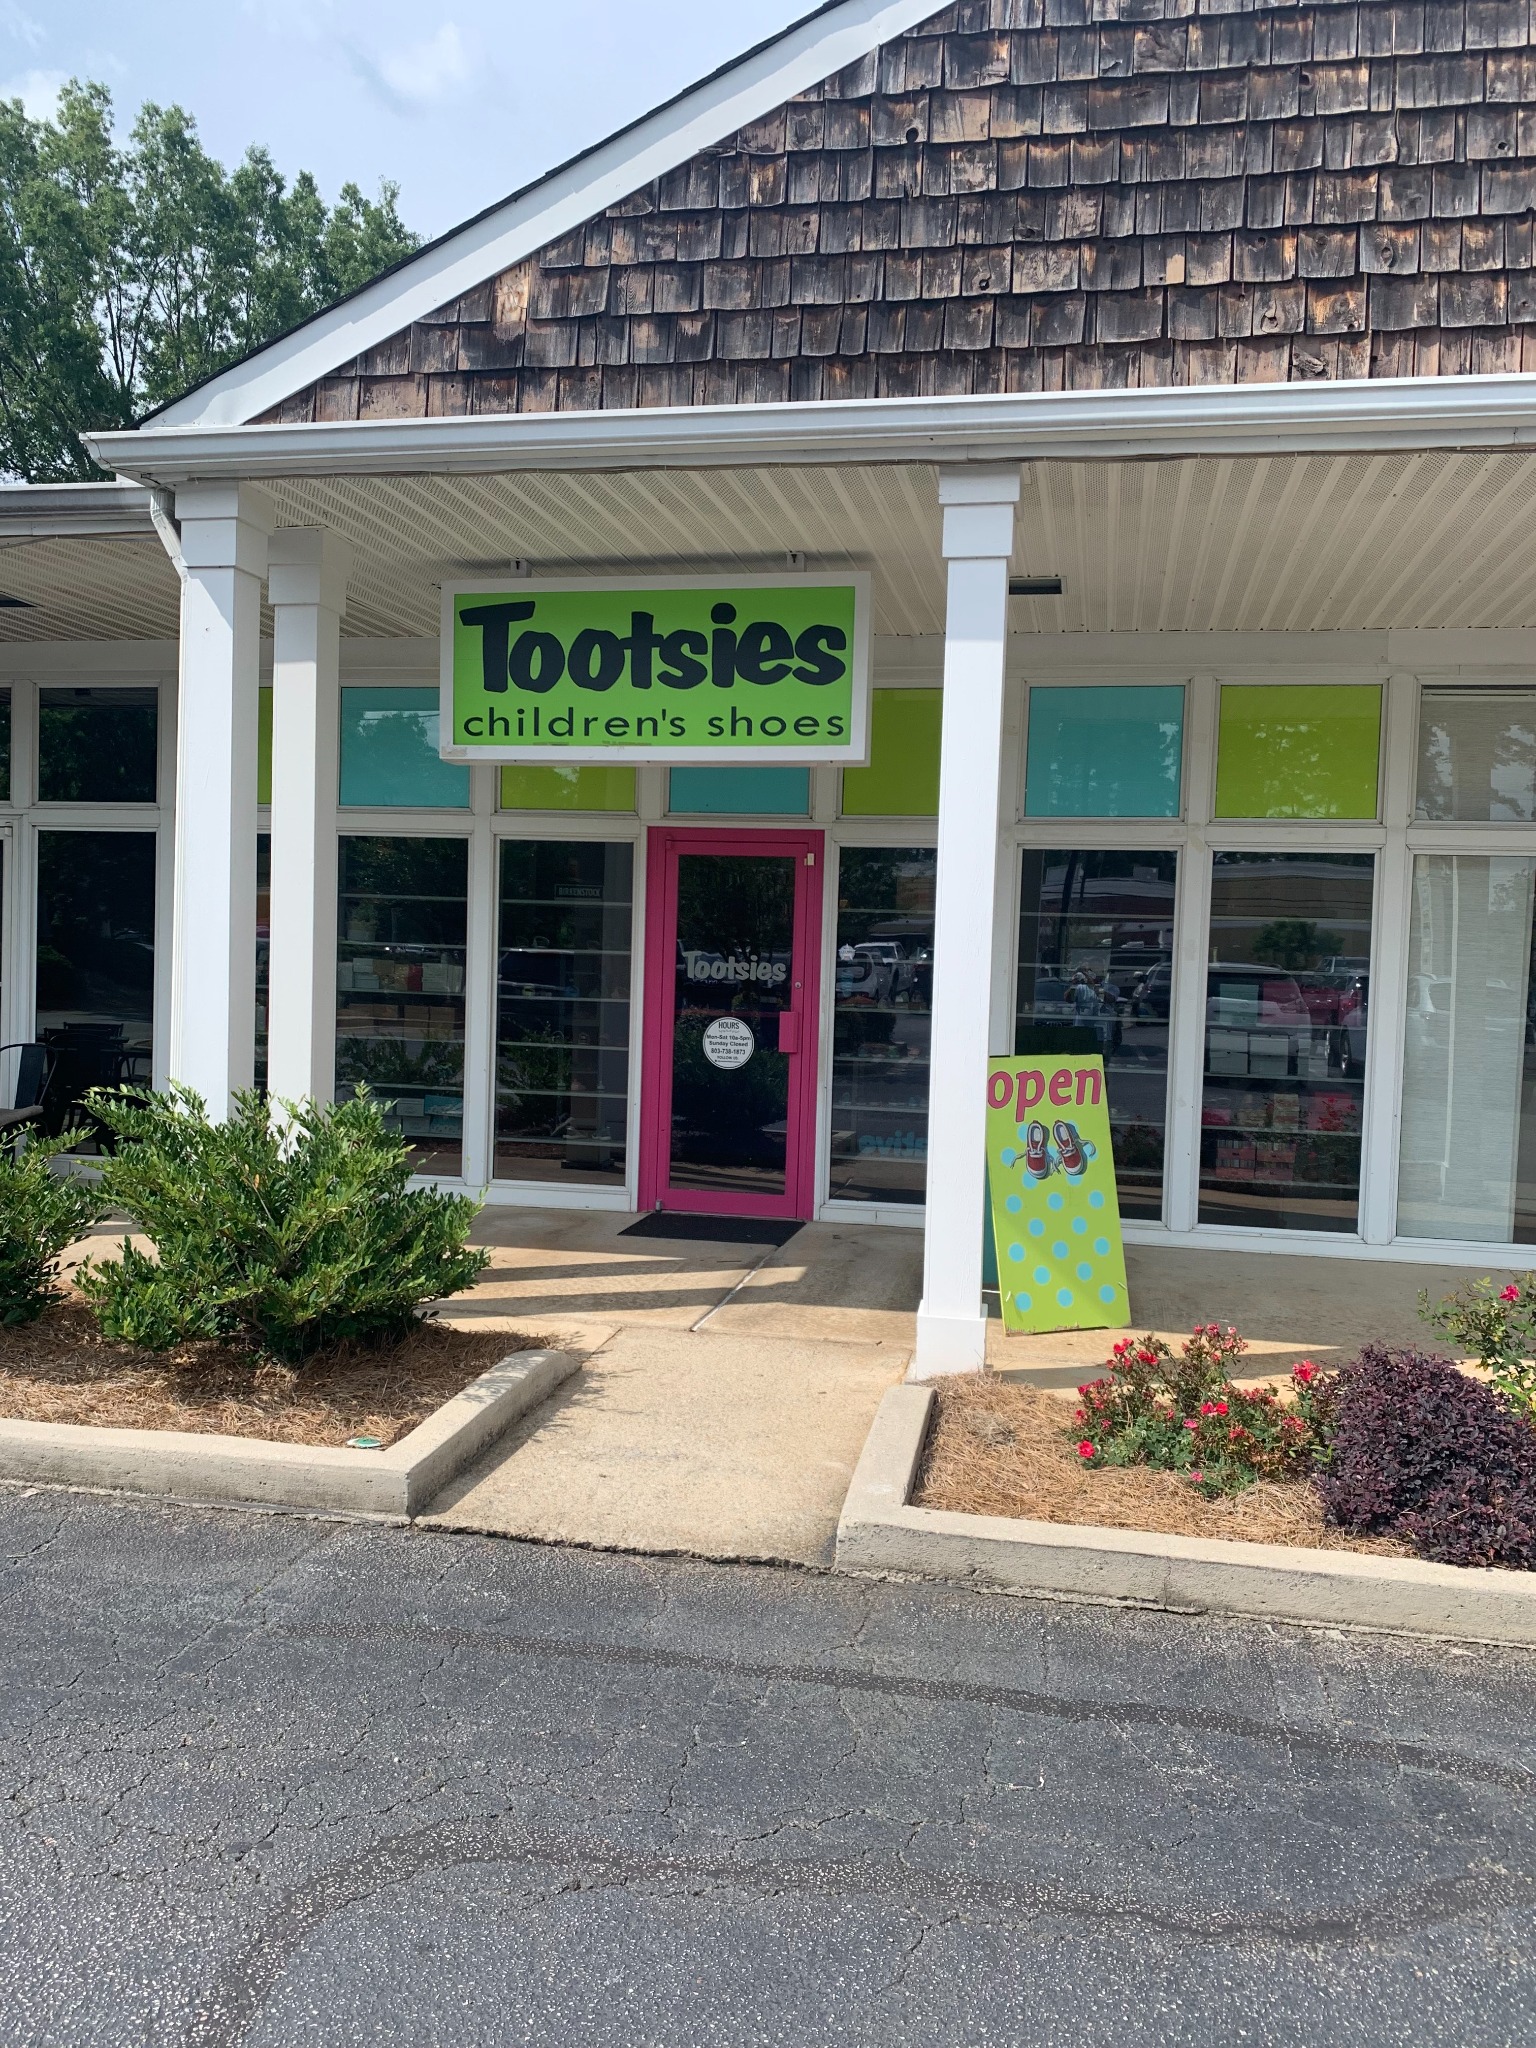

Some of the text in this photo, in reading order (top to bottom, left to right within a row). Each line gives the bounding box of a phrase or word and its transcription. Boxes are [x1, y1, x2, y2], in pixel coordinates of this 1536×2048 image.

[459, 601, 847, 693] Tootsies
[463, 706, 845, 738] children's shoes
[682, 950, 787, 981] Tootsies
[718, 1022, 740, 1030] HOURS
[988, 1068, 1102, 1122] open
